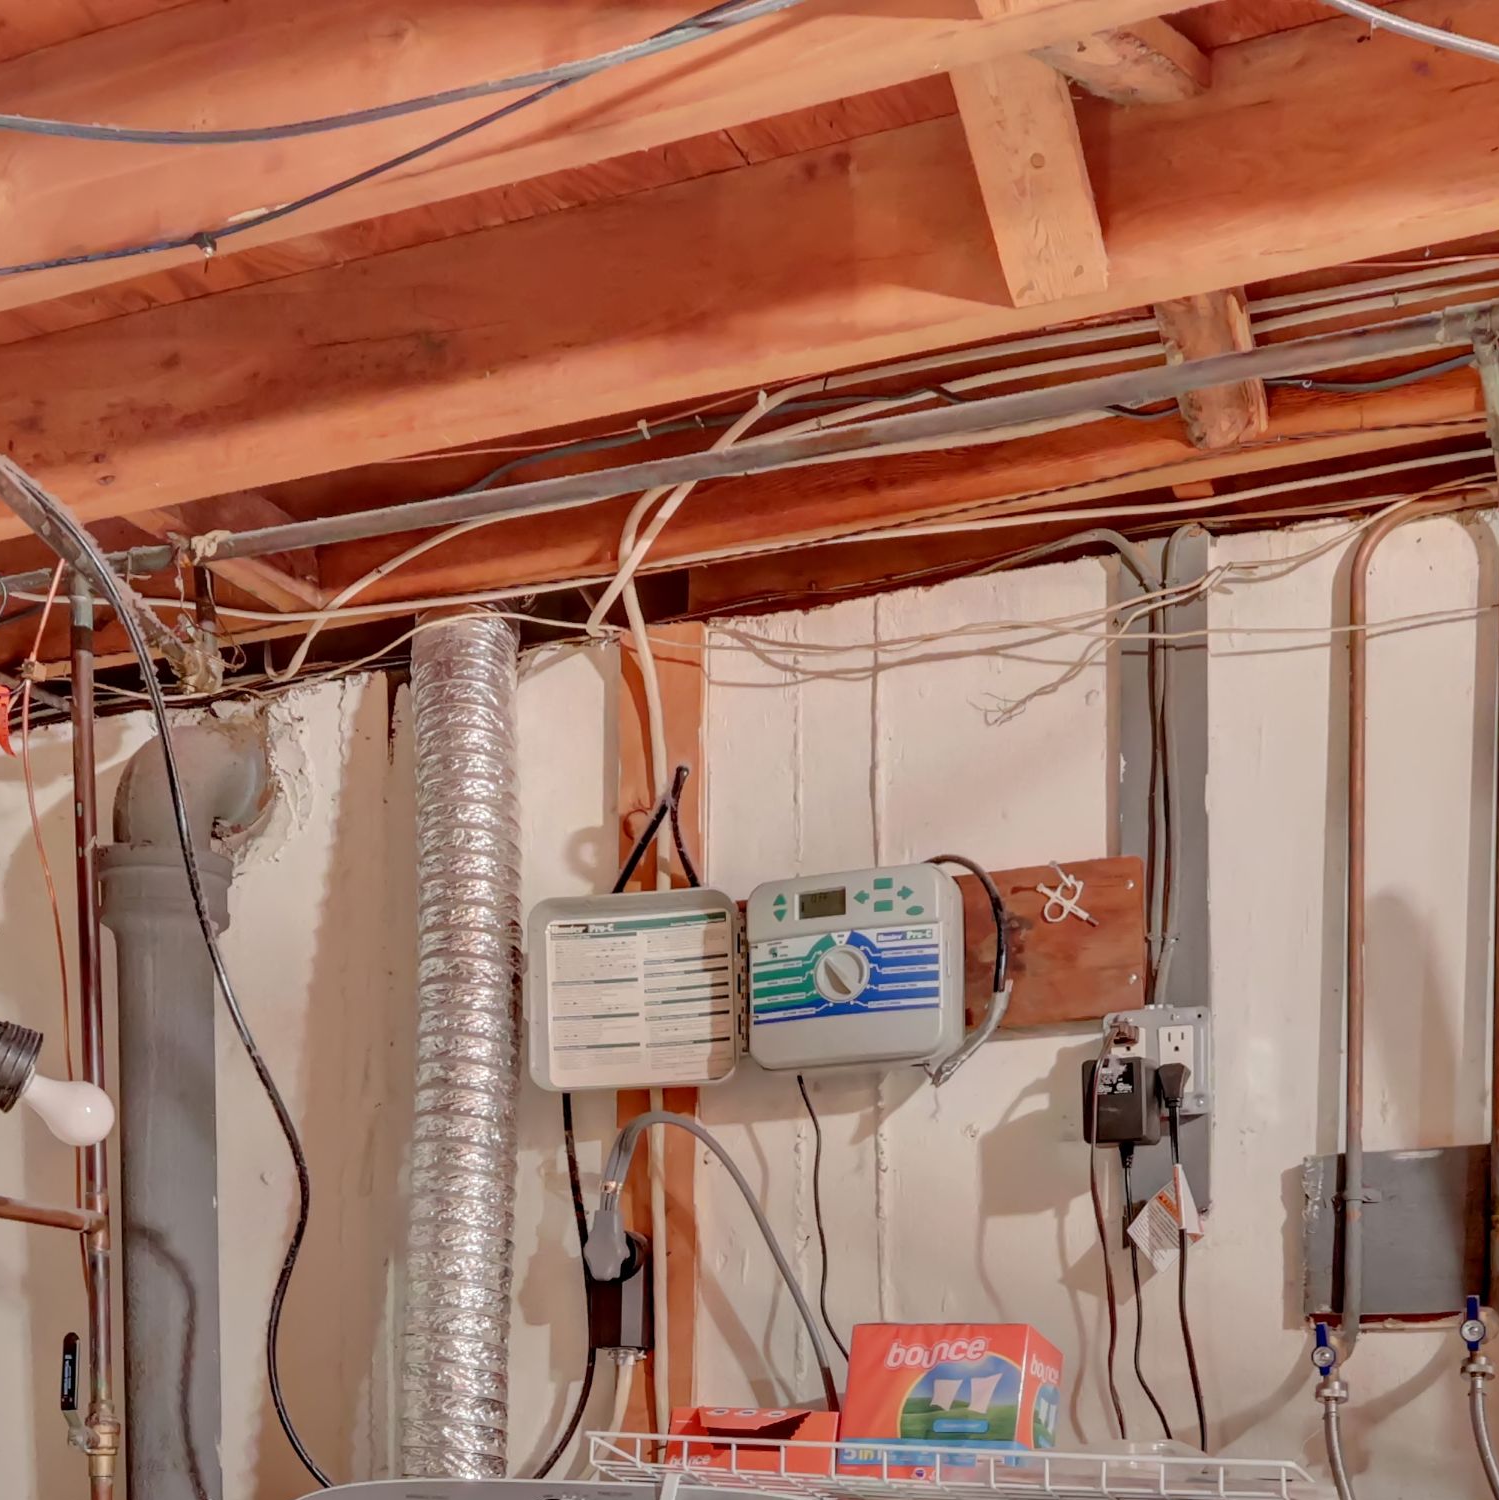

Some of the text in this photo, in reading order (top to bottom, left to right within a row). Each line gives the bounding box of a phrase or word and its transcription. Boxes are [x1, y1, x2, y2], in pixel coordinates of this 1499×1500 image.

[906, 929, 933, 940] Pro-C
[885, 1337, 988, 1370] bounce
[1030, 1353, 1060, 1385] bounce
[669, 1454, 712, 1467] bonce
